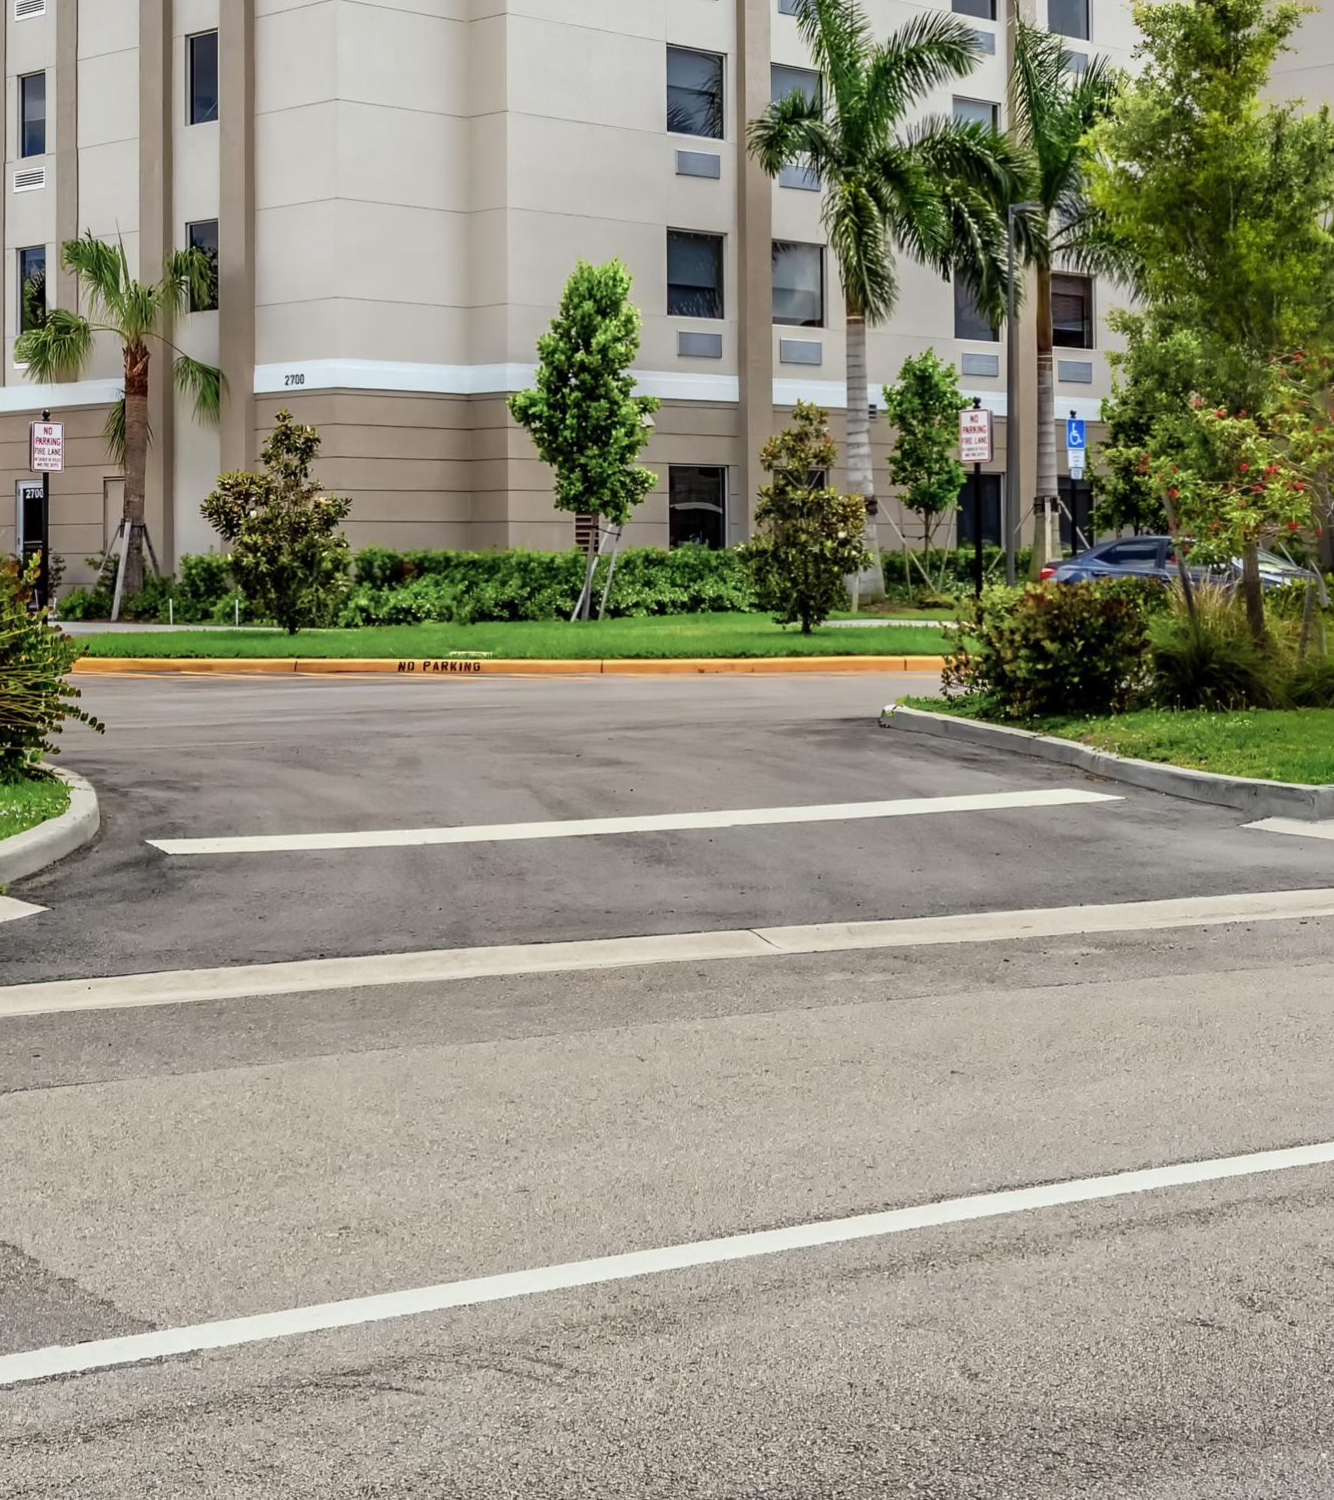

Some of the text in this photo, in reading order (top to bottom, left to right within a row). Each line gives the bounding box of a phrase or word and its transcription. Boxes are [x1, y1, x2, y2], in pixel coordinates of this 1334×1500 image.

[284, 373, 305, 386] 2700
[43, 426, 53, 436] NO
[35, 436, 61, 446] PARKING
[47, 448, 61, 457] LANE
[25, 488, 44, 499] 2700
[398, 660, 481, 673] NO PARKING
